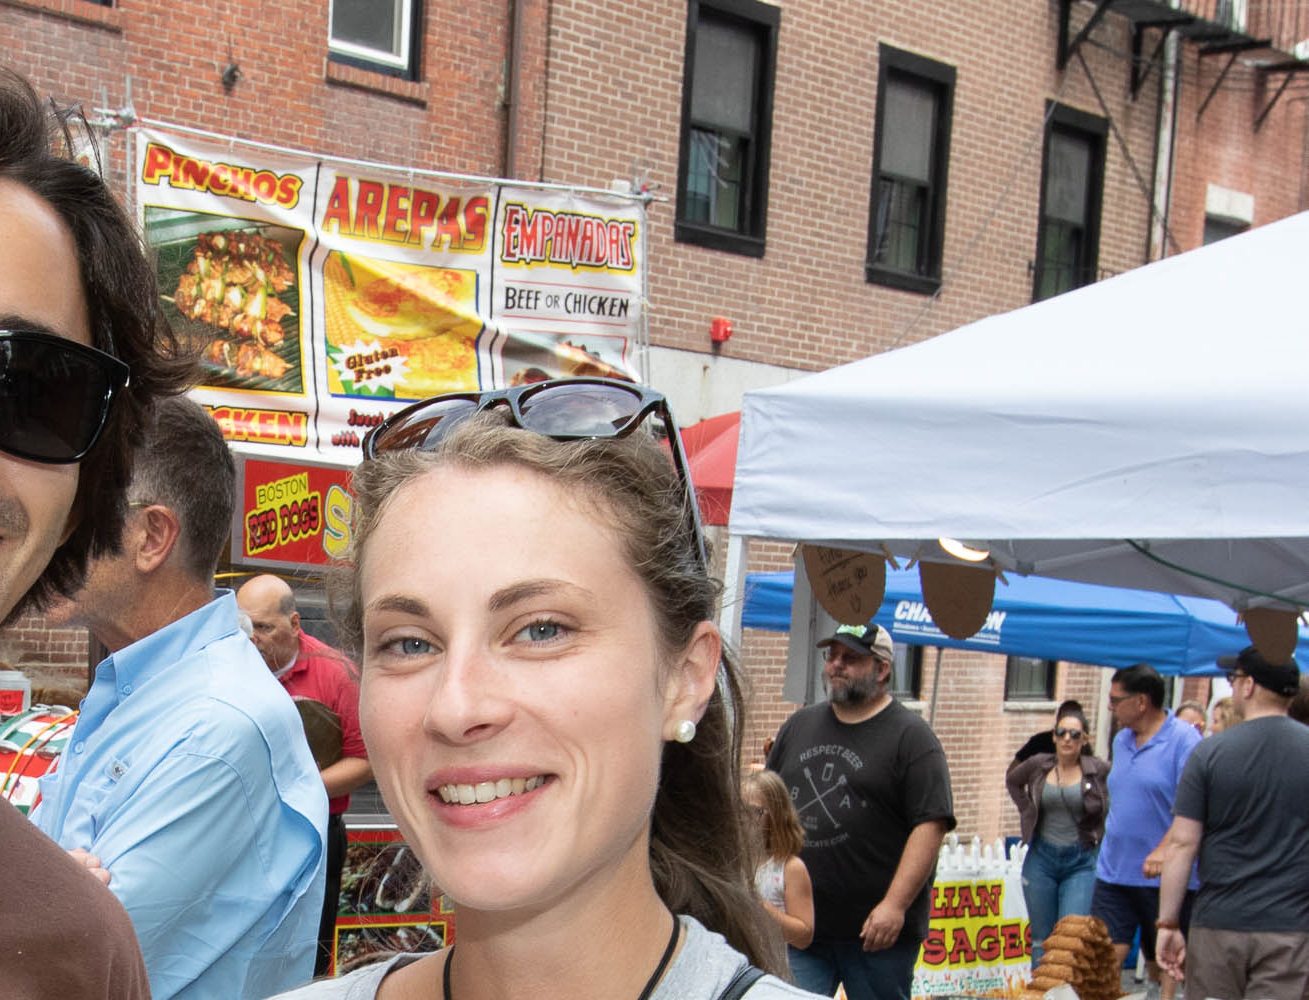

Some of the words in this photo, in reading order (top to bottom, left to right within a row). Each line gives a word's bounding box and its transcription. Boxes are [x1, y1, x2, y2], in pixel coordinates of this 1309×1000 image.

[142, 144, 303, 209] PINCHOS
[321, 174, 490, 253] AREPAS
[501, 203, 635, 271] EMPANADAS
[505, 286, 541, 311] BEEF
[564, 292, 630, 318] CHICKEN
[345, 348, 399, 370] Gluten
[354, 364, 392, 383] Free
[347, 409, 384, 427] Sweet
[257, 478, 308, 505] BOSTON
[247, 509, 278, 551] RED
[279, 495, 321, 541] DOGS
[800, 744, 843, 763] RESPECT
[930, 884, 1002, 919] LIAN
[922, 923, 1033, 966] SAGES
